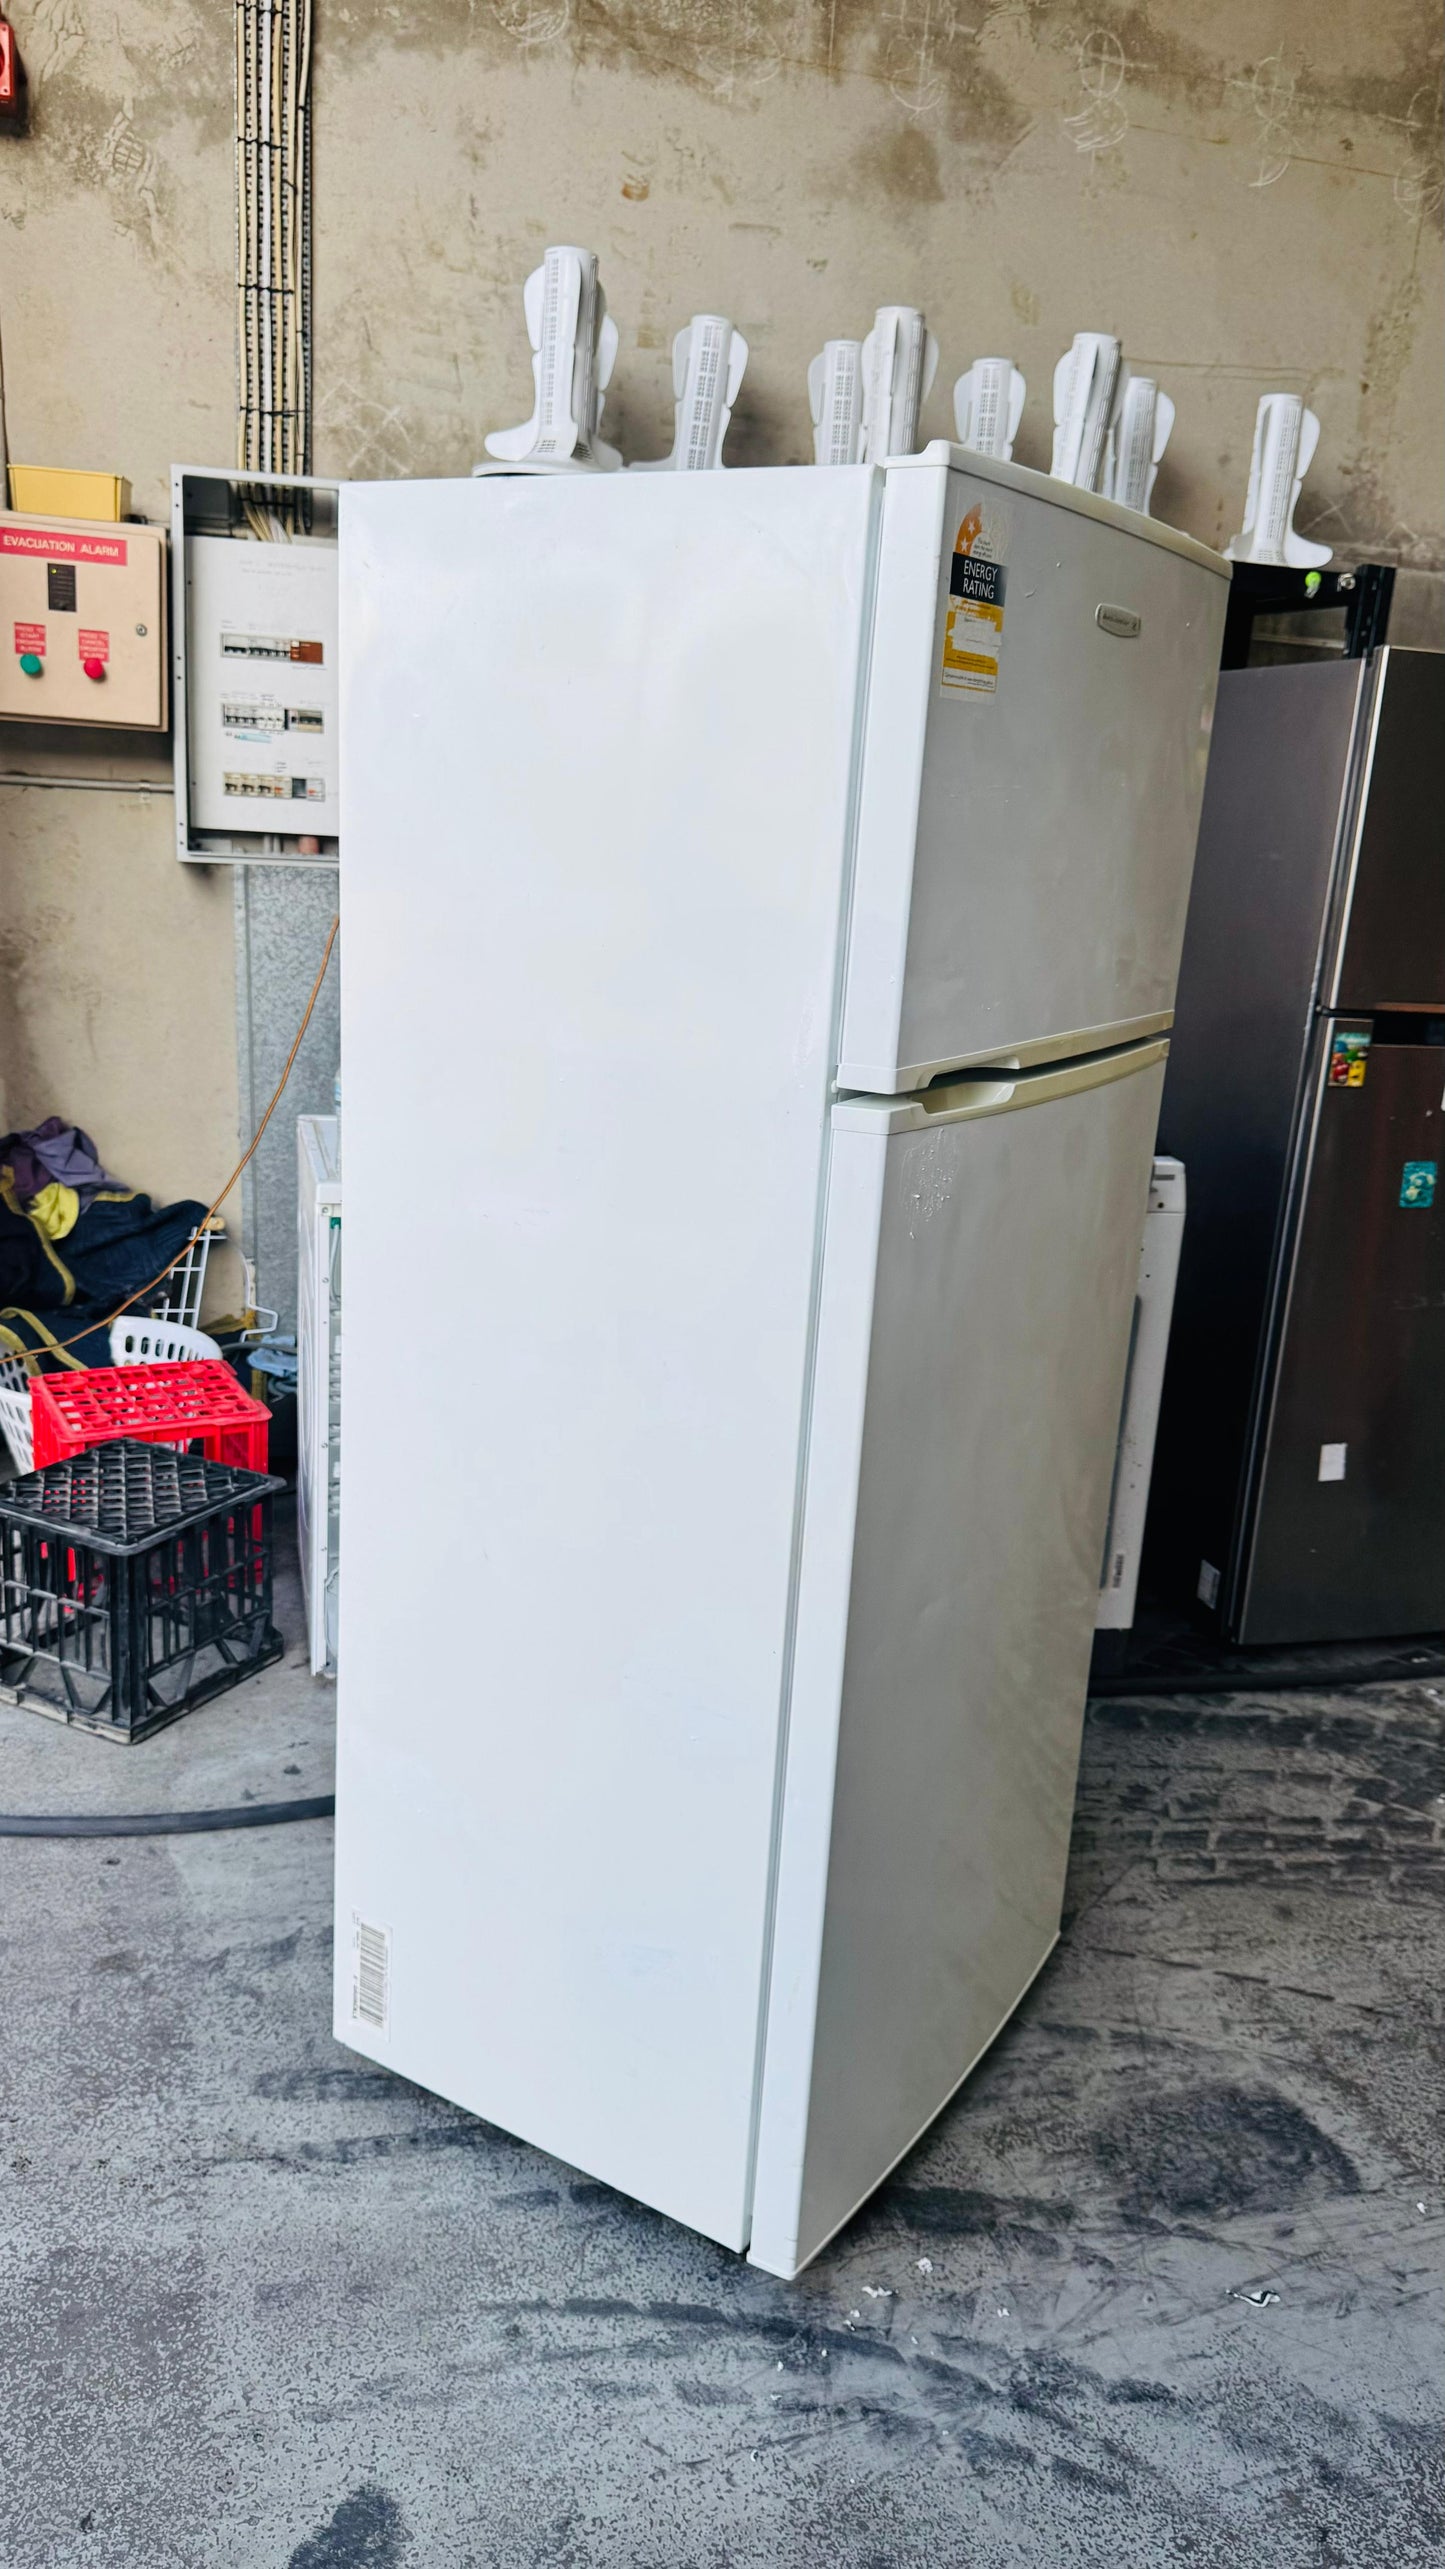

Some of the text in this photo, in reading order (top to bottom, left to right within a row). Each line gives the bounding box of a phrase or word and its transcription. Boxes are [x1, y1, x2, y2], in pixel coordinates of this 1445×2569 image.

[3, 535, 119, 557] EVACUATION ALARM
[963, 560, 998, 582] ENERGY
[962, 578, 994, 599] RATING
